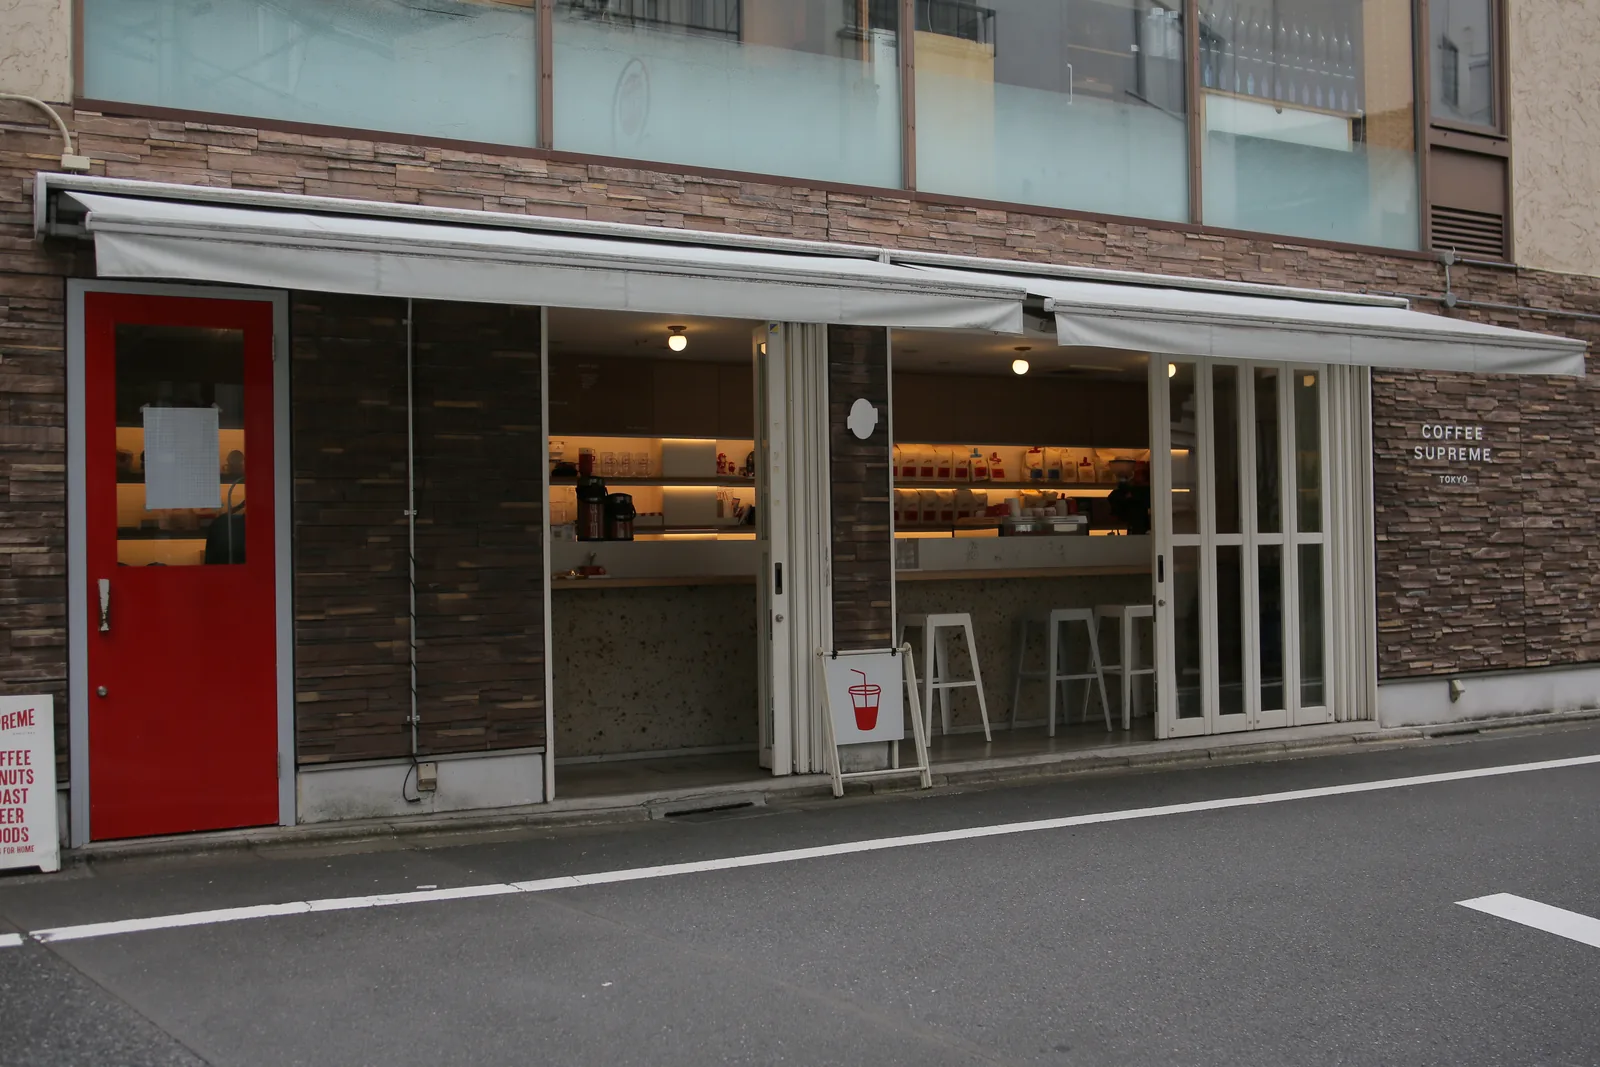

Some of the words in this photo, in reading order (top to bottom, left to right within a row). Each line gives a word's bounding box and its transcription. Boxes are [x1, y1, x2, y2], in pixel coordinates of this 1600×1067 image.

[1422, 424, 1483, 440] COFFEE
[1414, 446, 1491, 461] SUPREME
[1440, 475, 1468, 484] TOKYO
[0, 708, 35, 731] REME
[0, 788, 29, 805] AST
[3, 847, 14, 855] FOR
[17, 845, 35, 853] HOME
